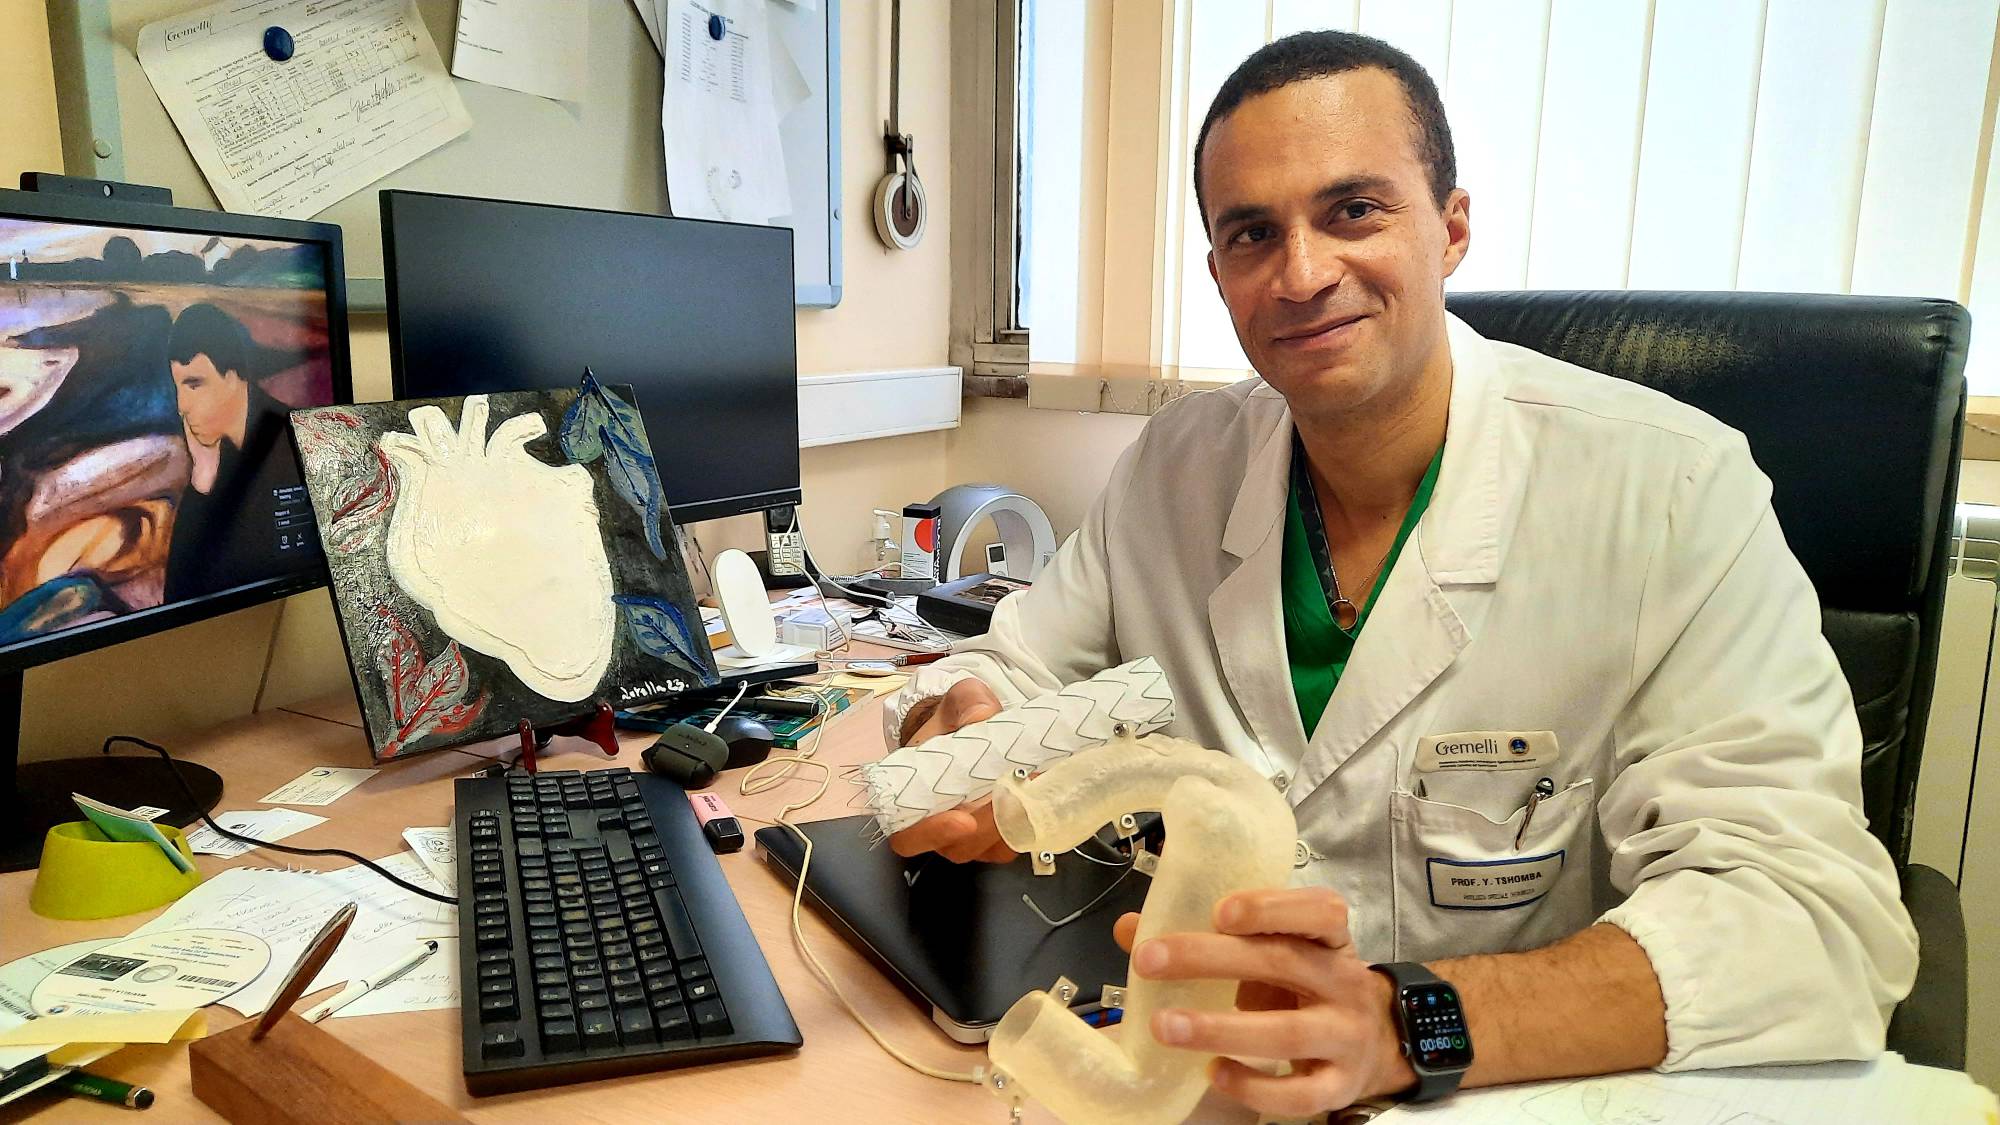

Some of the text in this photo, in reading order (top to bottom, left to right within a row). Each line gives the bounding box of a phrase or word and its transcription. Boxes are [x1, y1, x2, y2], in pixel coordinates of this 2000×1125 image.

[167, 20, 212, 42] Gemelli
[1435, 738, 1498, 756] Gemelli
[1450, 871, 1543, 887] PROF. Y. TSHOMBA
